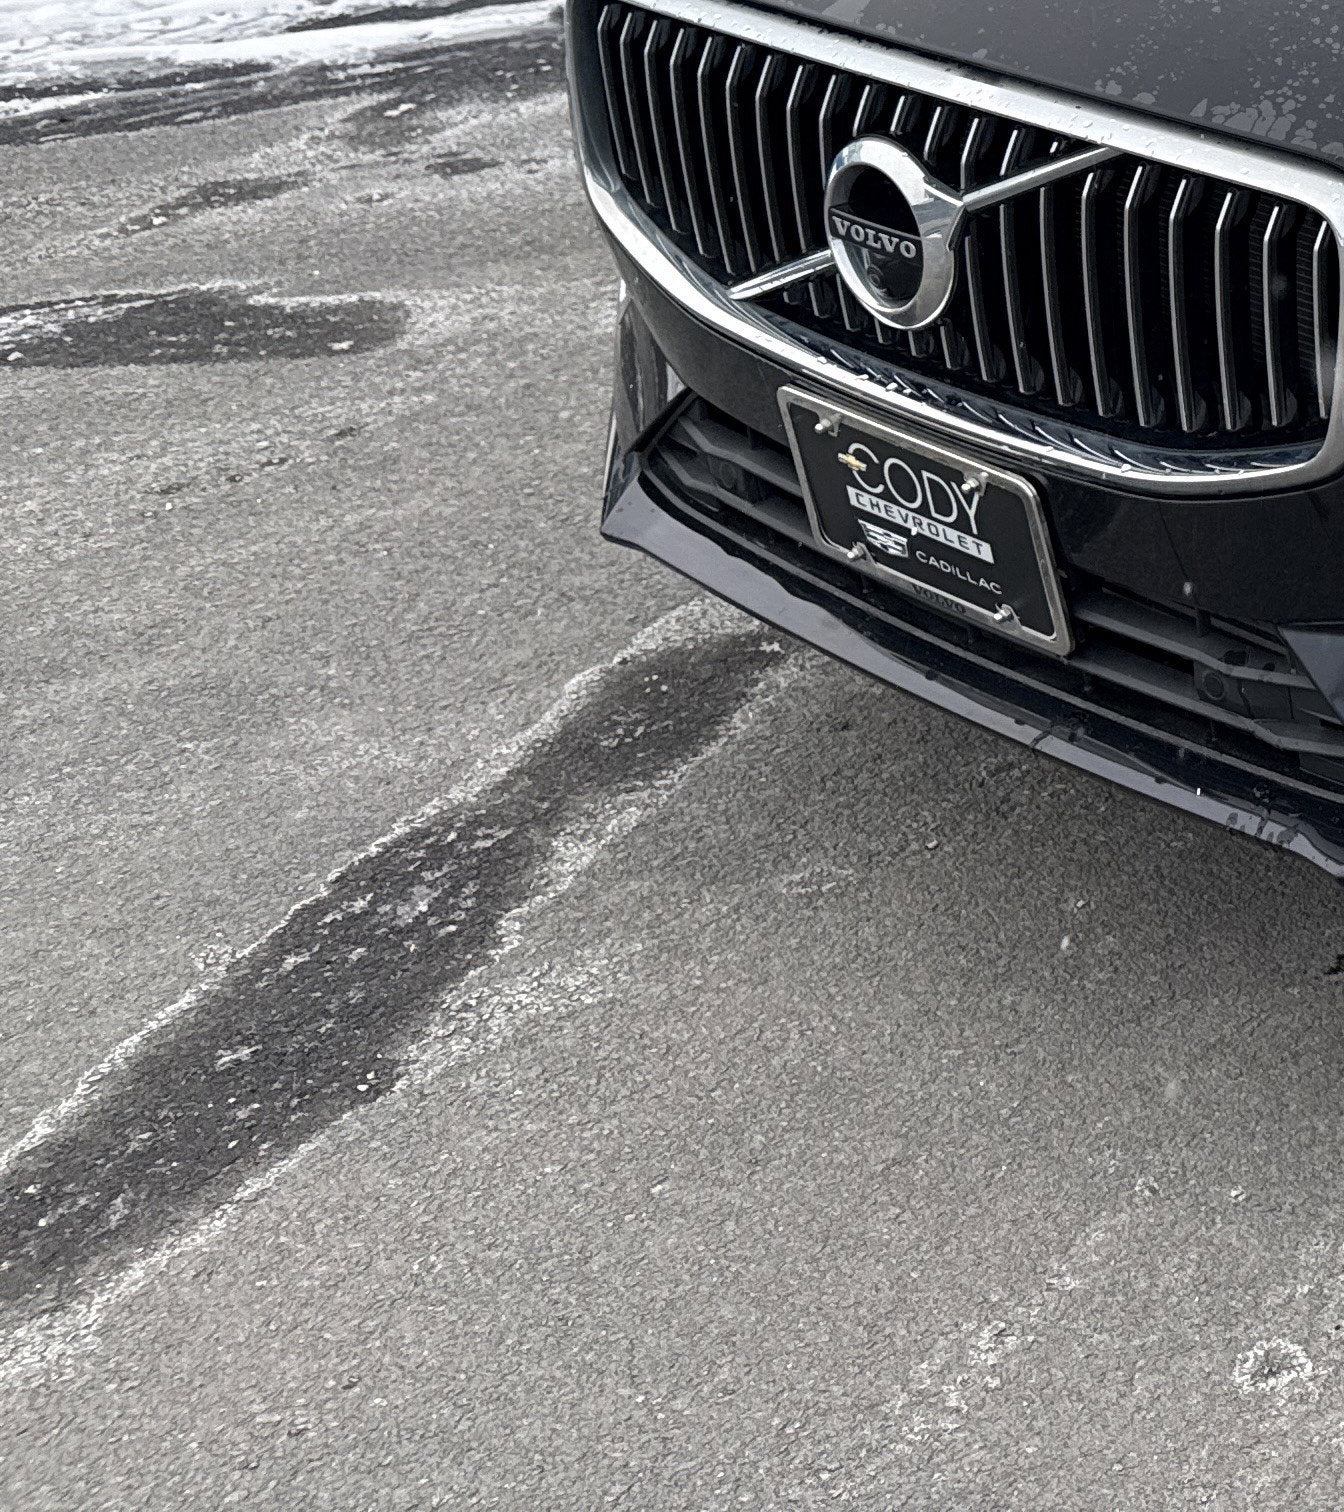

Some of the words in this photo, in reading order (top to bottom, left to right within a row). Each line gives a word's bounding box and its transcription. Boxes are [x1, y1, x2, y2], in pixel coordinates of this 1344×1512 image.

[832, 215, 917, 259] VOLVO
[847, 443, 983, 535] CODY
[855, 491, 986, 556] CHEVROLET
[915, 550, 1003, 595] CADILLAC
